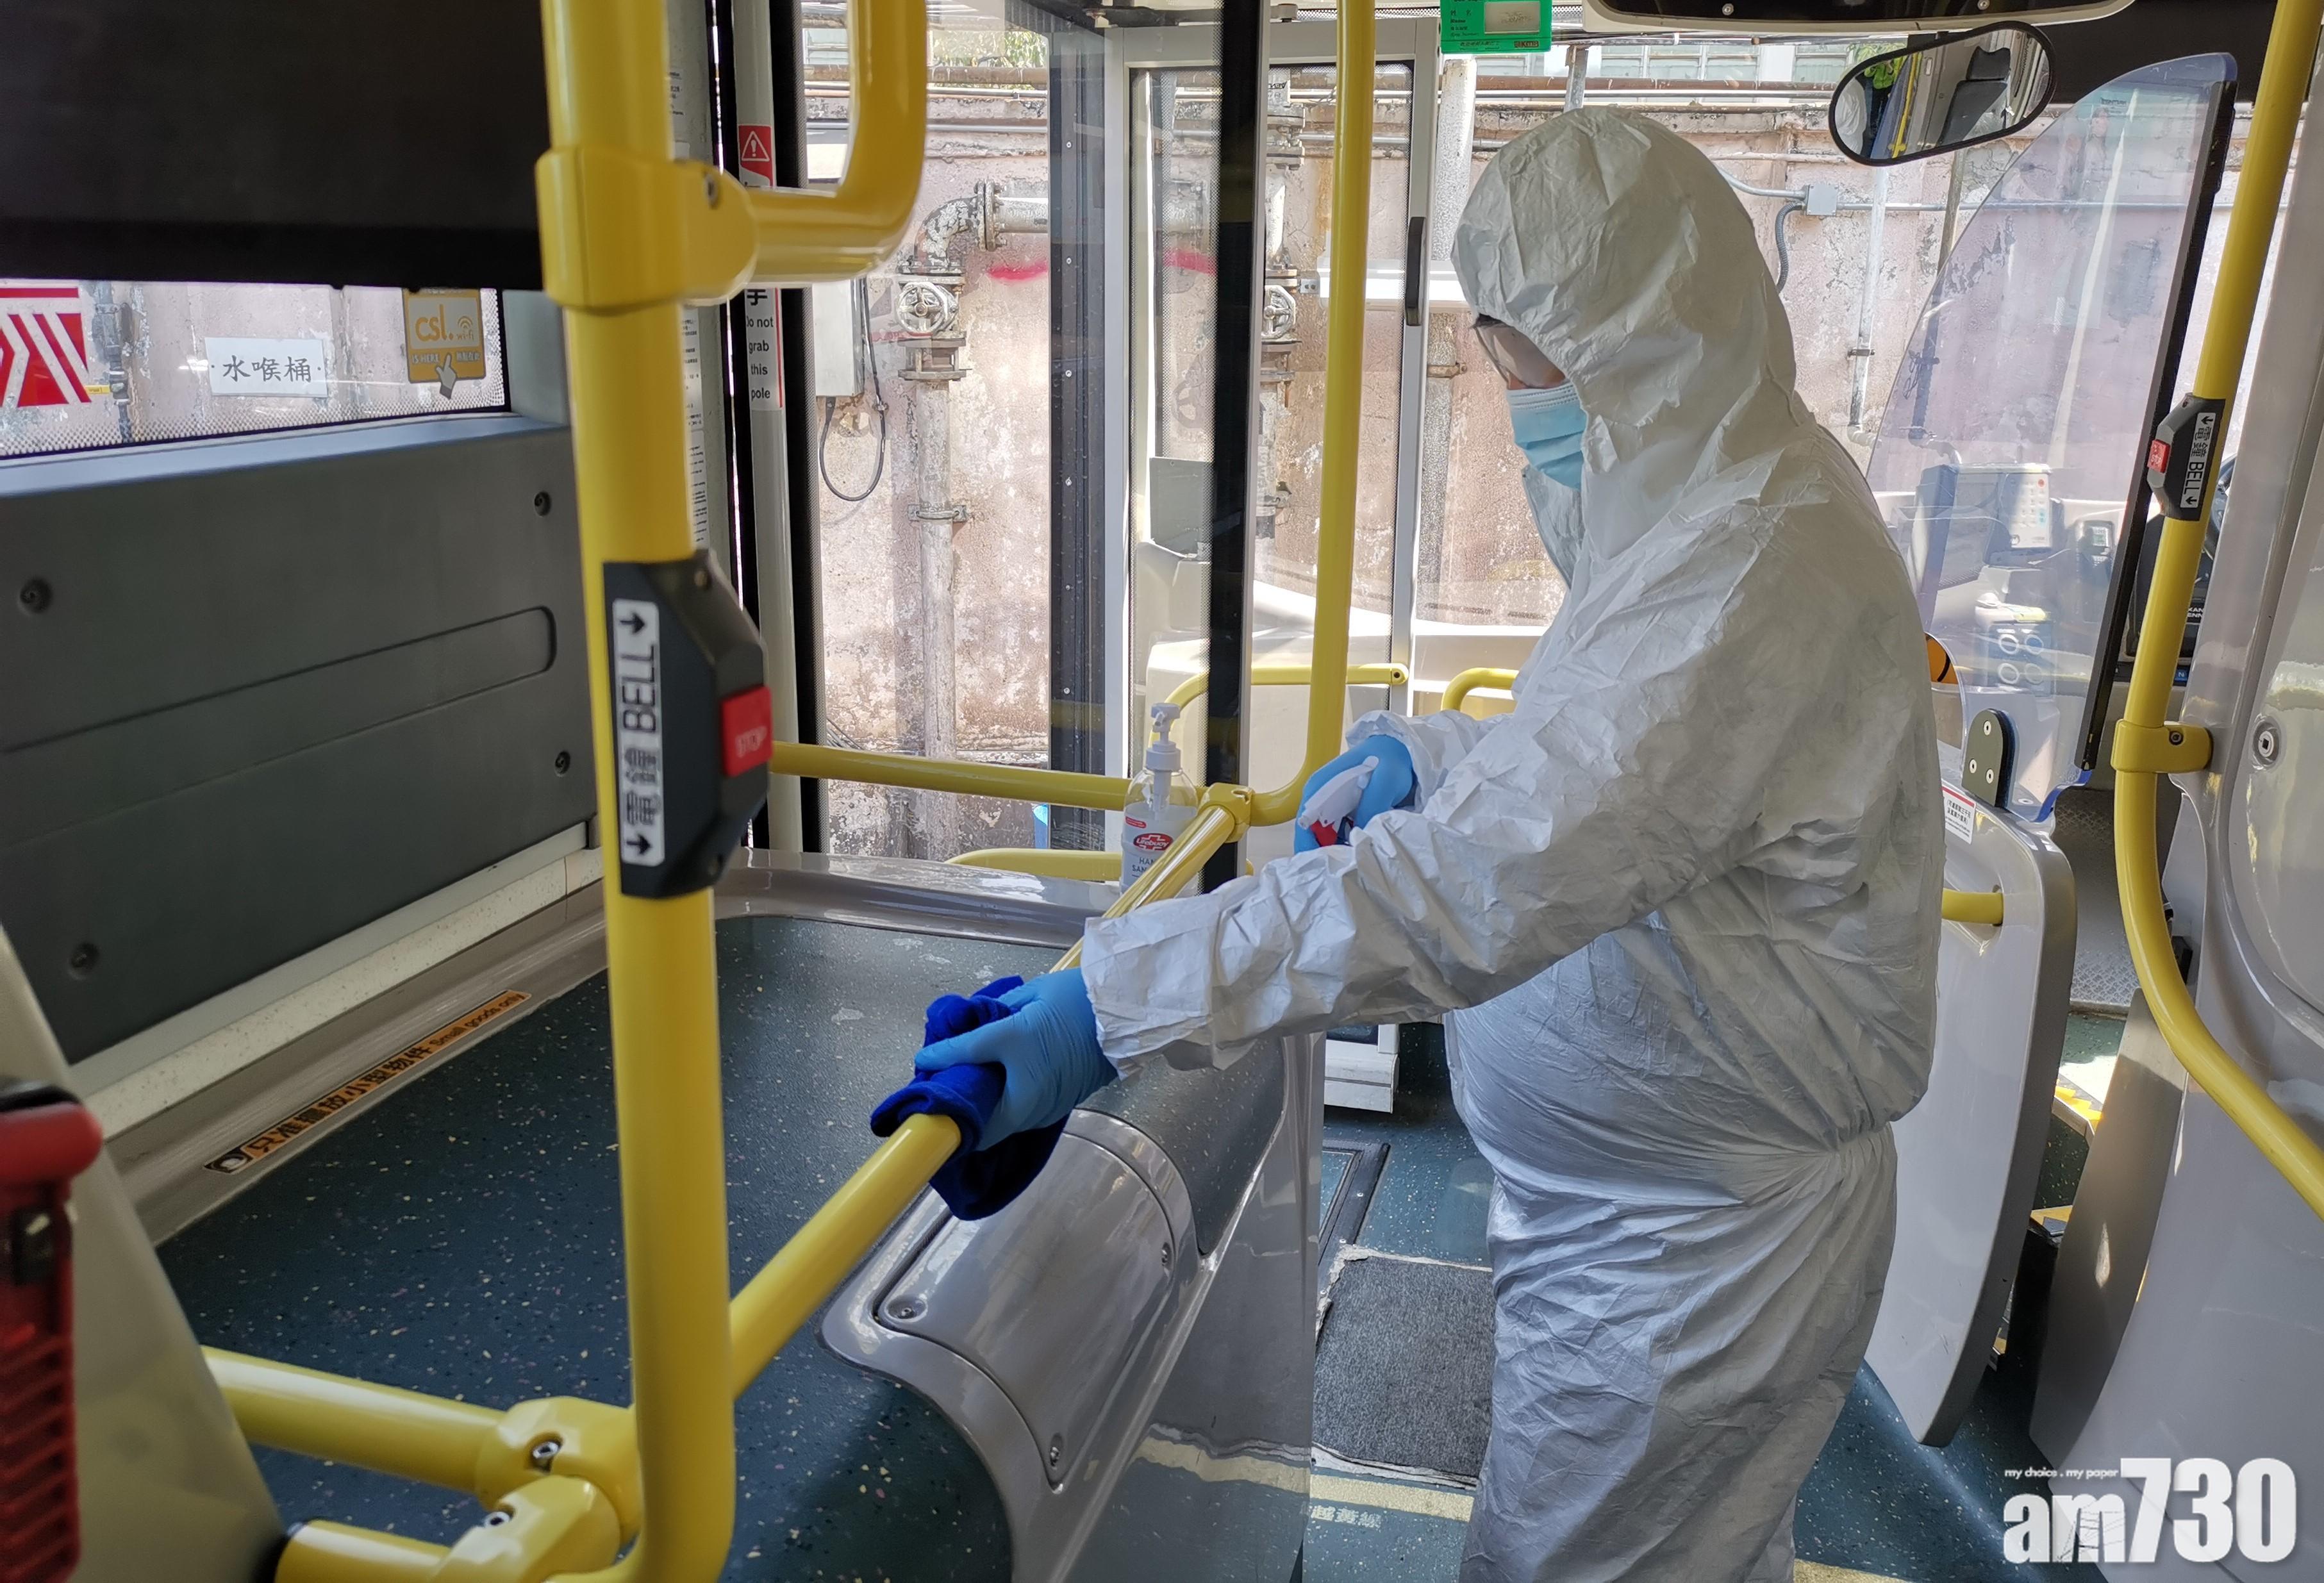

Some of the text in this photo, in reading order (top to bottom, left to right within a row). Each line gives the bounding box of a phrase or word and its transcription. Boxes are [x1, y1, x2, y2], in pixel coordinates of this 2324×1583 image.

[757, 317, 774, 327] not
[749, 340, 769, 354] grab
[222, 354, 311, 383] 水喉桶
[751, 363, 768, 376] this
[751, 387, 771, 401] pole
[2184, 461, 2205, 495] BELL
[622, 644, 656, 733] BELL
[1136, 837, 1170, 847] Lifebuoy
[428, 993, 526, 1047] Small goods only
